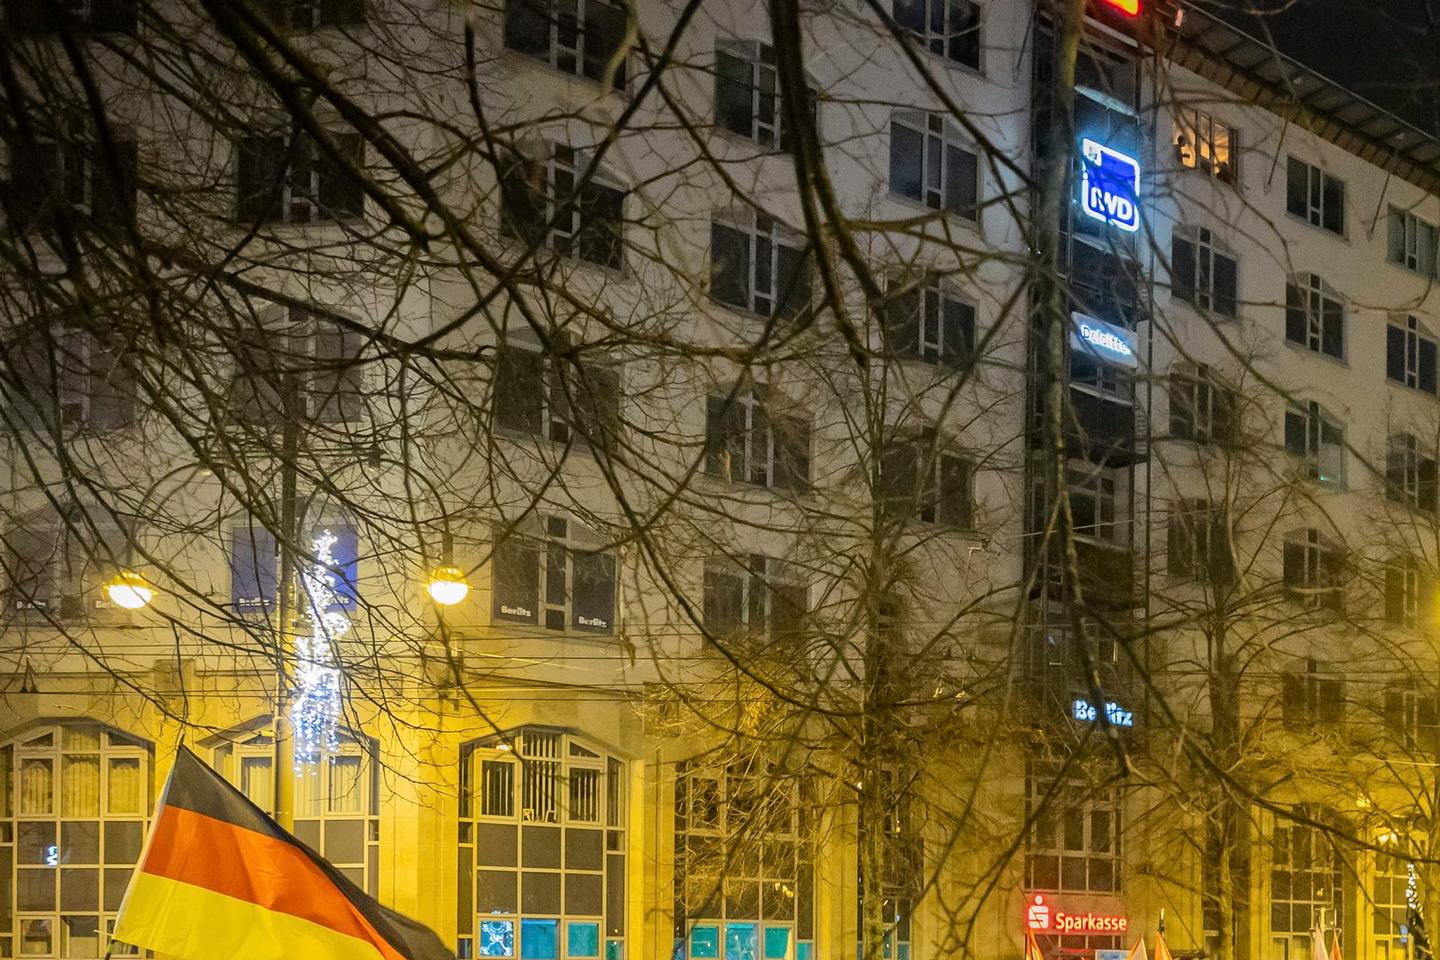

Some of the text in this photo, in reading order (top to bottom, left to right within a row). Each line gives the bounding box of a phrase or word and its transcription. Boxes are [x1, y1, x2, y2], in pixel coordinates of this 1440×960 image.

[578, 616, 606, 627] Berlitz
[1075, 700, 1133, 726] Belitz
[1055, 912, 1127, 933] Sparkasse
